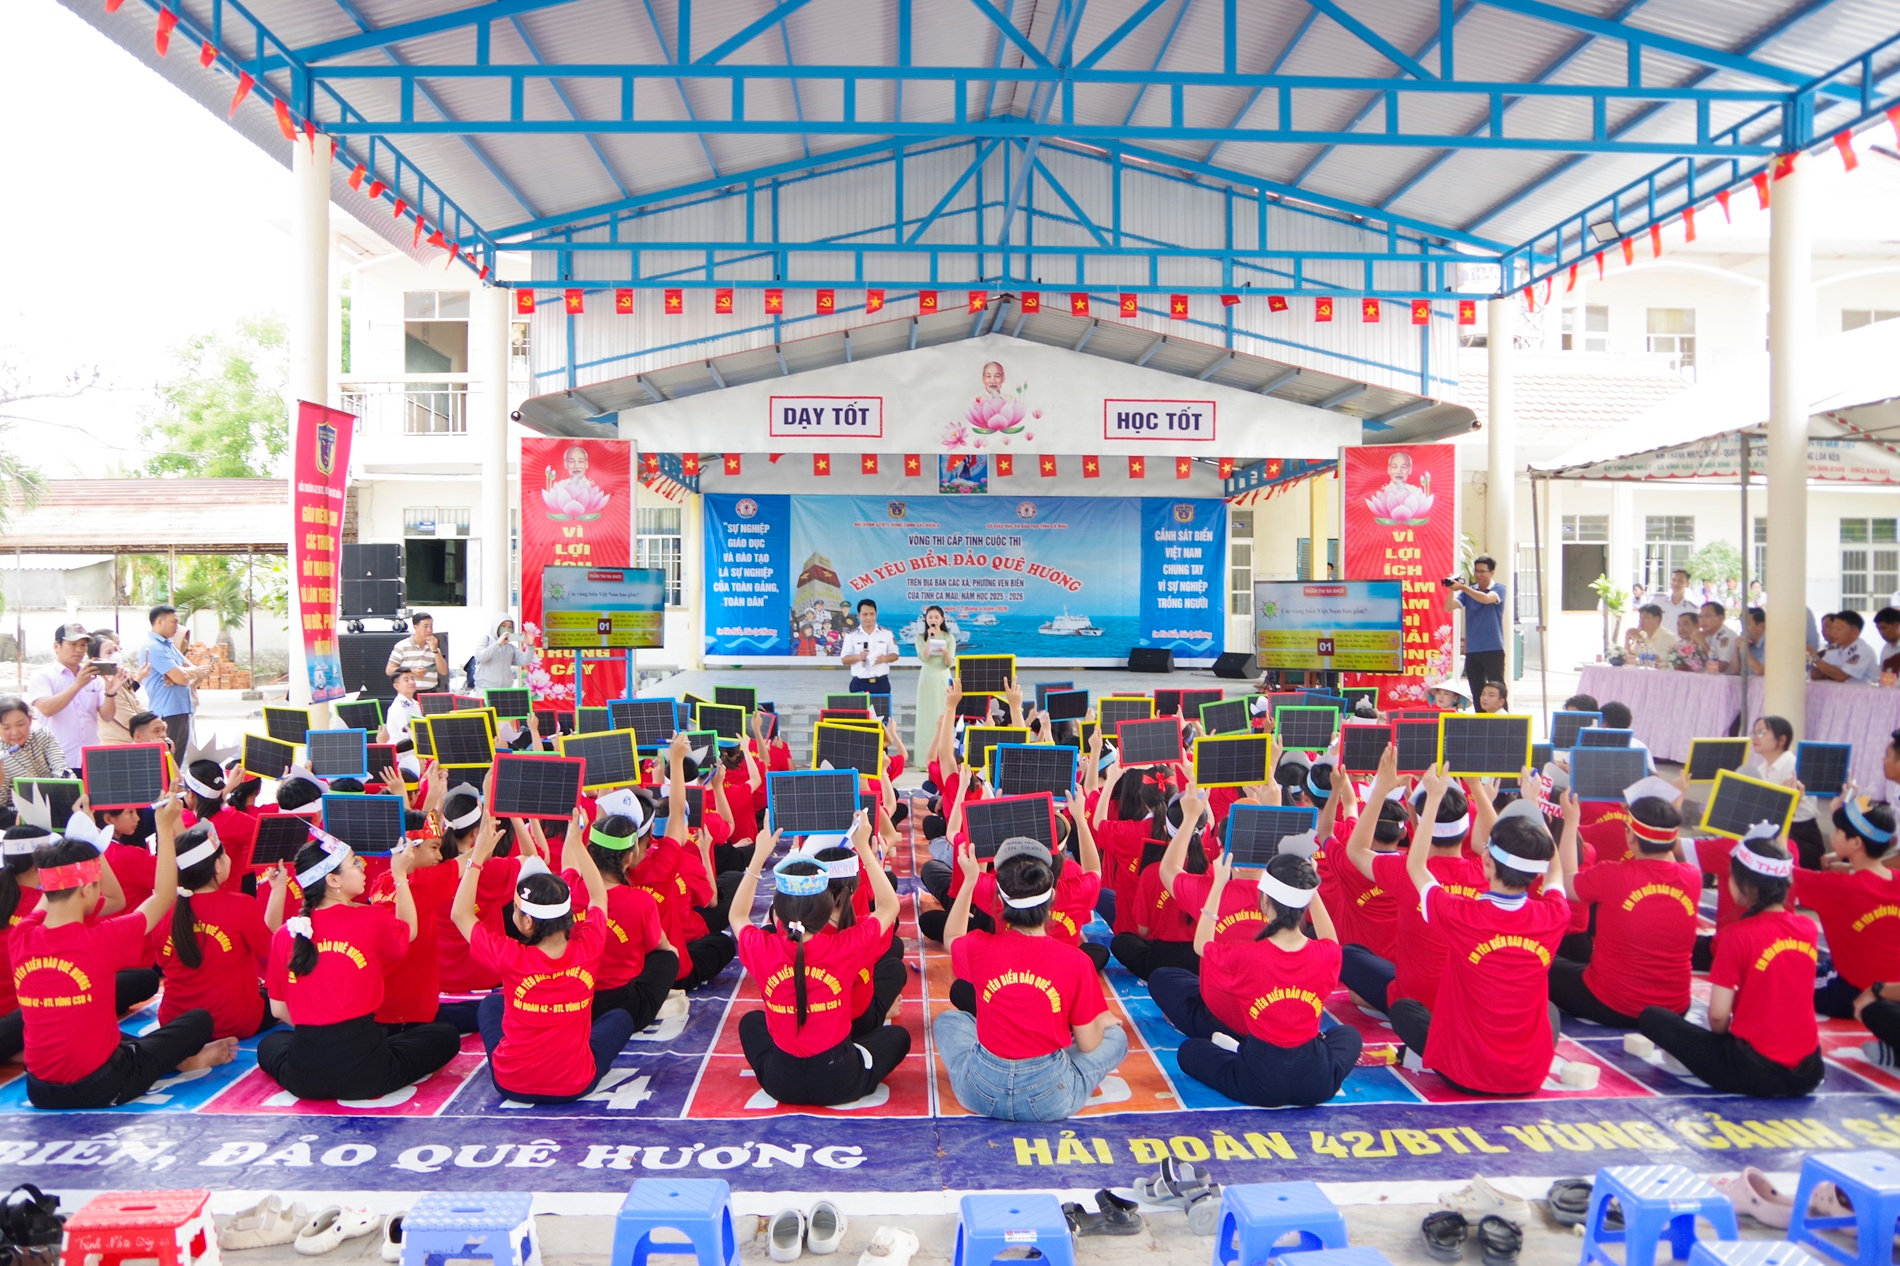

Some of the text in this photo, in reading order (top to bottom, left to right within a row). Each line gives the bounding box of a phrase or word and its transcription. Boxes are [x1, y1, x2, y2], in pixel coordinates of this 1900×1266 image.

[784, 401, 870, 429] DẠY TỐT
[1117, 406, 1202, 434] HỌC TỐT
[562, 524, 585, 538] VÌ
[740, 522, 770, 536] NGHIỆP
[1154, 527, 1213, 541] CẢNH SÁT BIỂN
[1392, 529, 1415, 542] VÌ
[727, 537, 746, 548] GIÁO
[909, 533, 930, 546] VÒNG
[932, 536, 945, 545] THI
[947, 534, 963, 546] CẤP
[986, 535, 1007, 548] CUỘC
[1009, 536, 1021, 546] THI
[554, 541, 591, 560] LỢI
[1165, 546, 1202, 560] VIỆT NAM
[1385, 545, 1422, 561] LỢI
[723, 551, 734, 562] VÀ
[754, 553, 769, 565] TẠO
[744, 566, 774, 581] NGHIỆP
[849, 573, 875, 591] EM
[873, 562, 906, 580] YÊU
[953, 549, 988, 566] ĐẢO
[991, 556, 1025, 572] QUÊ
[1027, 563, 1082, 592] HƯƠNG
[1162, 564, 1204, 575] CHUNG TAY
[1383, 563, 1423, 577] ÍCH
[713, 579, 730, 592] CỦA
[731, 580, 753, 592] TOÀN
[907, 578, 922, 587] TRÊN
[997, 579, 1009, 588] VEN
[1157, 579, 1208, 594] VÌ SỰ NGHIỆP
[724, 595, 745, 607] TOÀN
[1157, 595, 1208, 608] TRỒNG NGƯỜI
[599, 622, 609, 631] 01
[1319, 642, 1331, 651] 01
[317, 938, 332, 952] ĐẢO
[1489, 933, 1507, 951] BIỂN
[986, 977, 1002, 993] YÊU
[1000, 968, 1018, 986] BIỂN
[1019, 969, 1035, 985] ĐẢO
[1034, 976, 1052, 992] QUÊ
[1254, 997, 1269, 1011] YÊU
[1266, 985, 1285, 1004] BIỂN
[1285, 985, 1301, 999] ĐẢO
[540, 1004, 549, 1013] 42
[1013, 1112, 1855, 1166] HẢI ĐOÀN 42/BTL VÙNG CẢNH
[198, 1134, 869, 1173] ĐẢO QUÊ HƯƠNG
